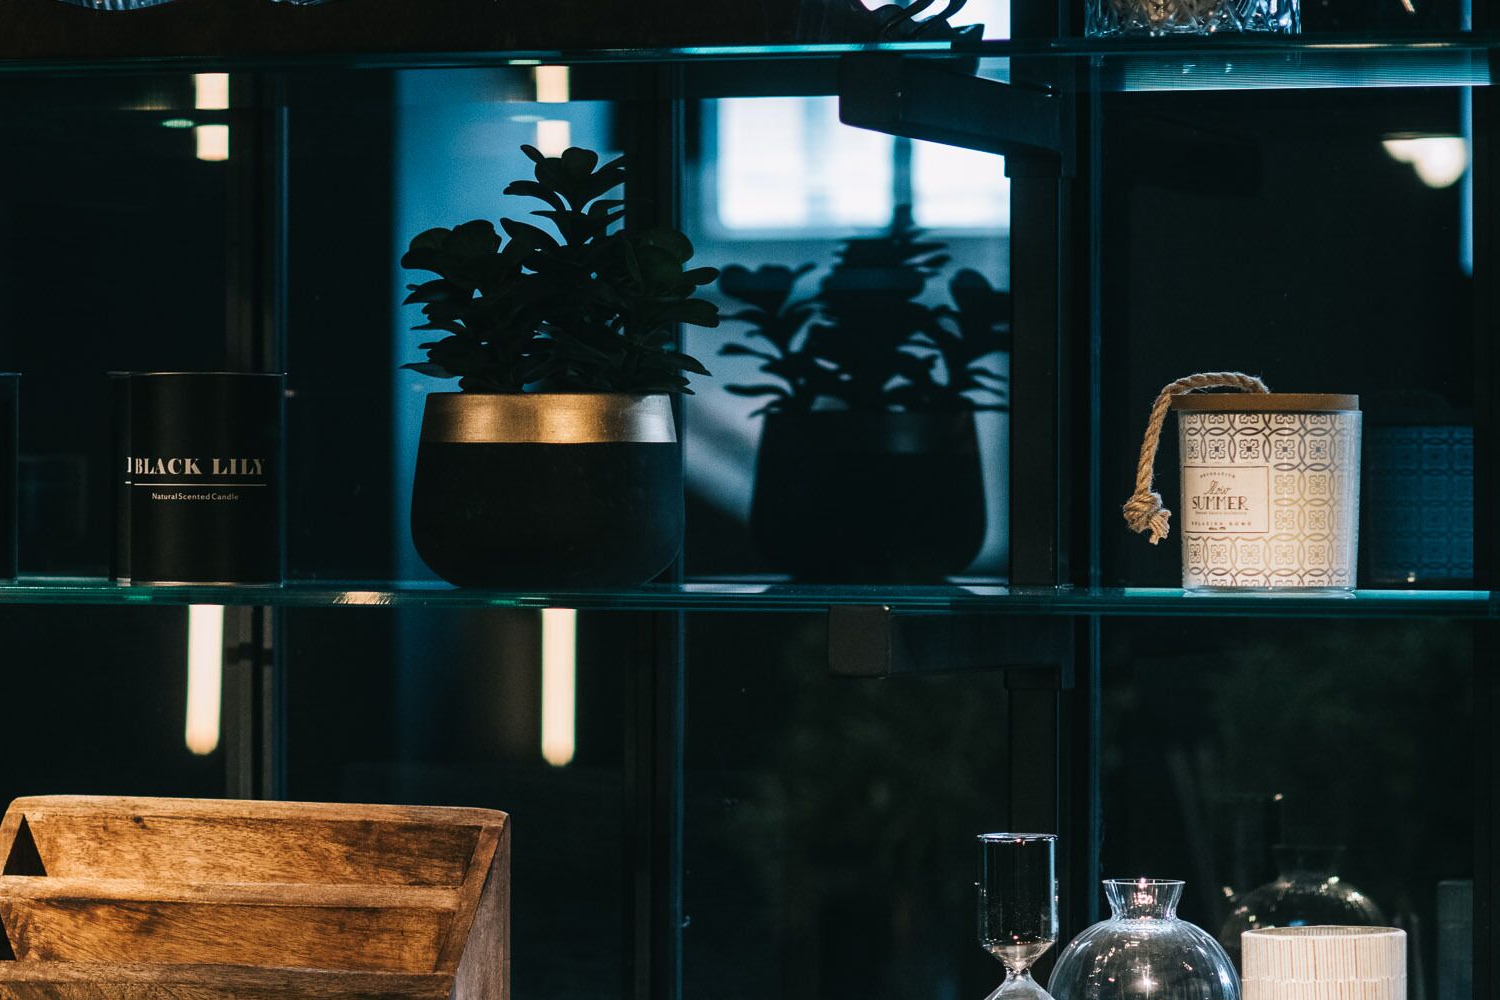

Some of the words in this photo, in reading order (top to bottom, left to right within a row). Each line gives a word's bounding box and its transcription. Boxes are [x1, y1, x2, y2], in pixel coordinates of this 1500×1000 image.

[135, 457, 203, 475] BLACK
[212, 457, 266, 475] LILY
[1192, 495, 1249, 511] SUMMER
